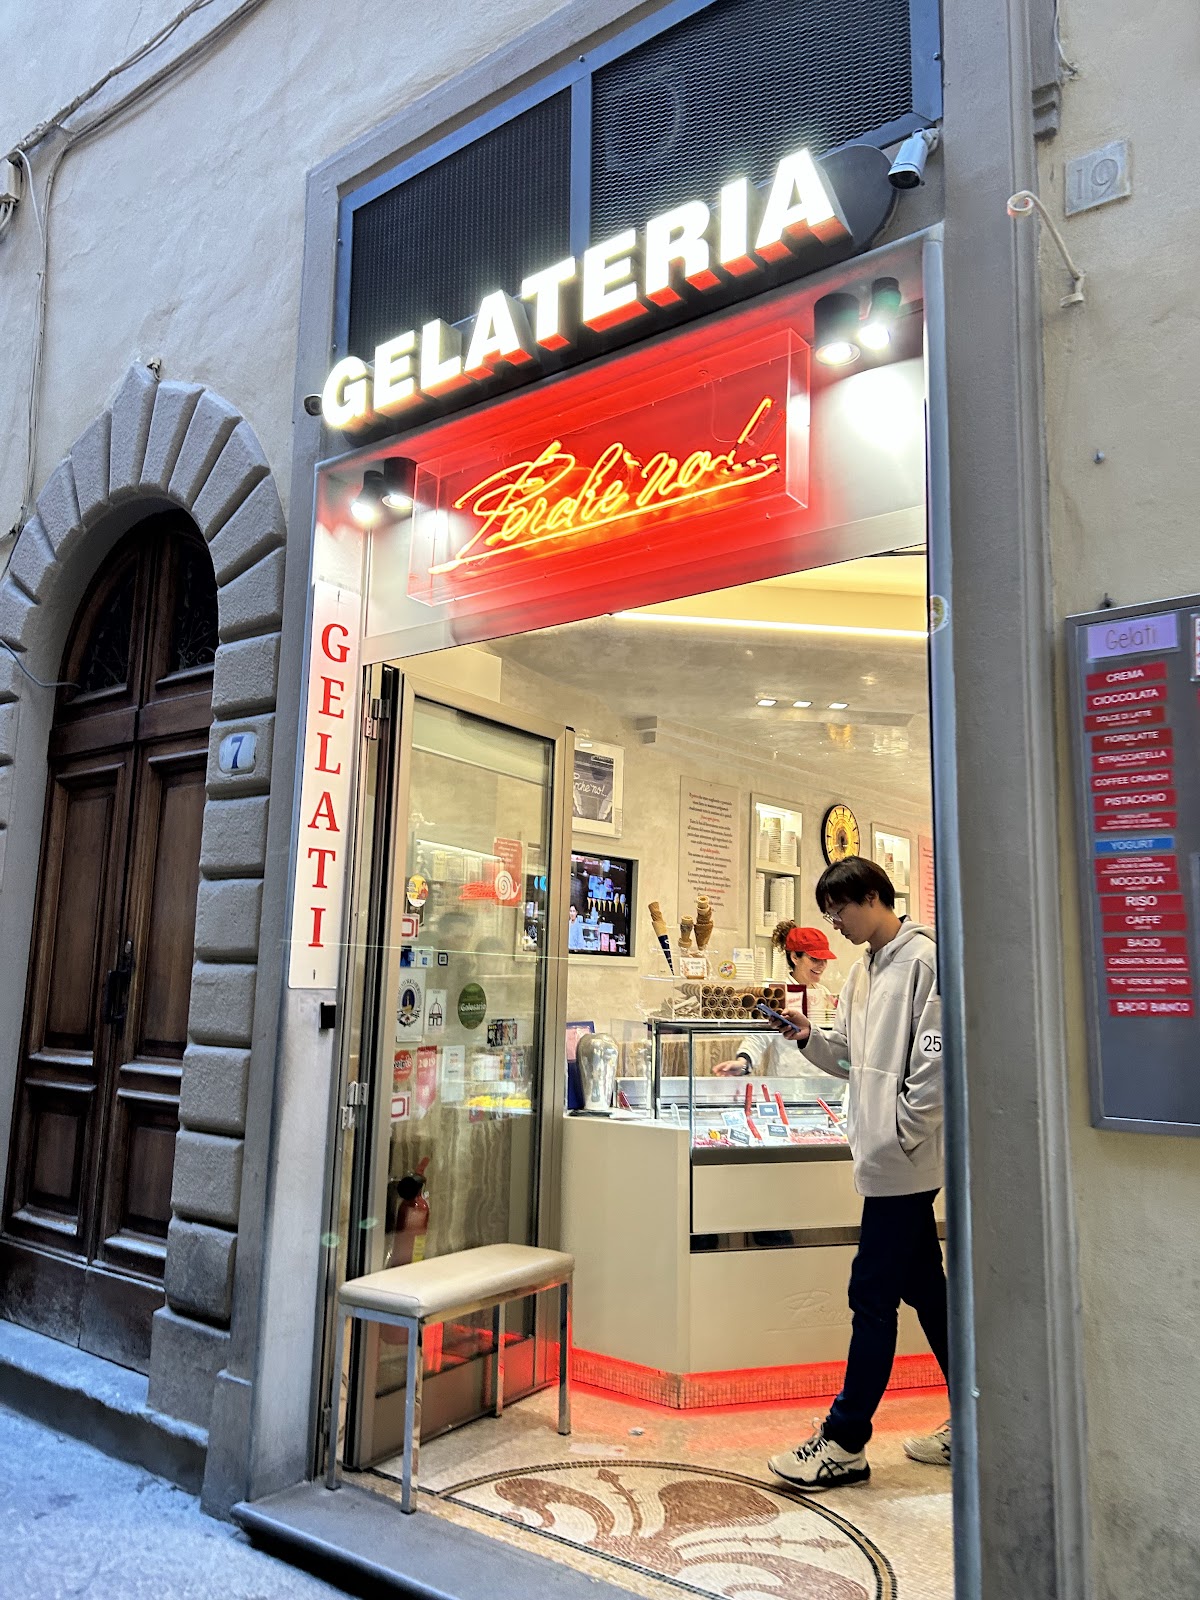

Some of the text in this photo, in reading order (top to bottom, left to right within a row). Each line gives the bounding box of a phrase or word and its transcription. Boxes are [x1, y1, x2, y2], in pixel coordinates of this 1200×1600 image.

[1076, 158, 1119, 200] 19
[321, 147, 838, 430] GELATERIA
[1105, 625, 1156, 650] Gelati
[1105, 669, 1145, 683] CREMA
[1092, 688, 1160, 706] CIOCCOLATA
[1096, 713, 1120, 723] DOLCE
[231, 735, 245, 769] 7
[1098, 750, 1168, 764] STRACCIATELLA
[308, 623, 350, 948] GELATI
[1094, 773, 1169, 787] COFFEE CRUNCH
[1104, 793, 1167, 806] PISTACCHIO
[1110, 840, 1154, 850] YOGURT
[1109, 876, 1165, 886] NOCCIOLA
[1125, 896, 1158, 906] RISO
[1127, 938, 1161, 947] BACIO
[1116, 1002, 1191, 1013] BACIO BIANCO
[923, 1035, 942, 1052] 25
